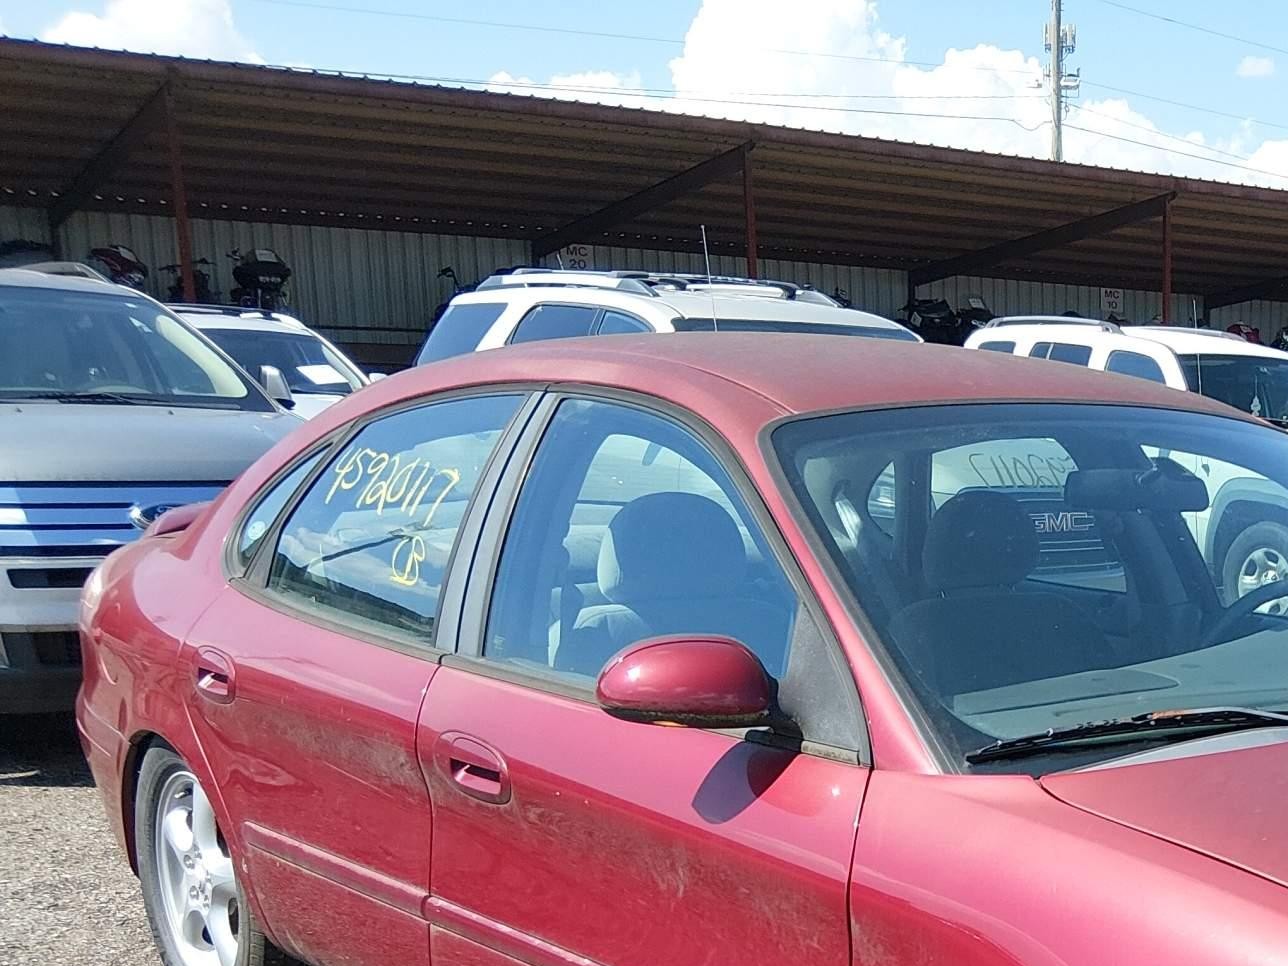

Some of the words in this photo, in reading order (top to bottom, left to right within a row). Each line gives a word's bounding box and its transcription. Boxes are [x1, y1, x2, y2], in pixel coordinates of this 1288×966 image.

[566, 246, 588, 257] MC
[569, 259, 586, 269] 20
[1104, 290, 1120, 299] MC
[1106, 301, 1118, 309] 10
[324, 448, 461, 527] 45920117
[1028, 512, 1095, 533] GMC
